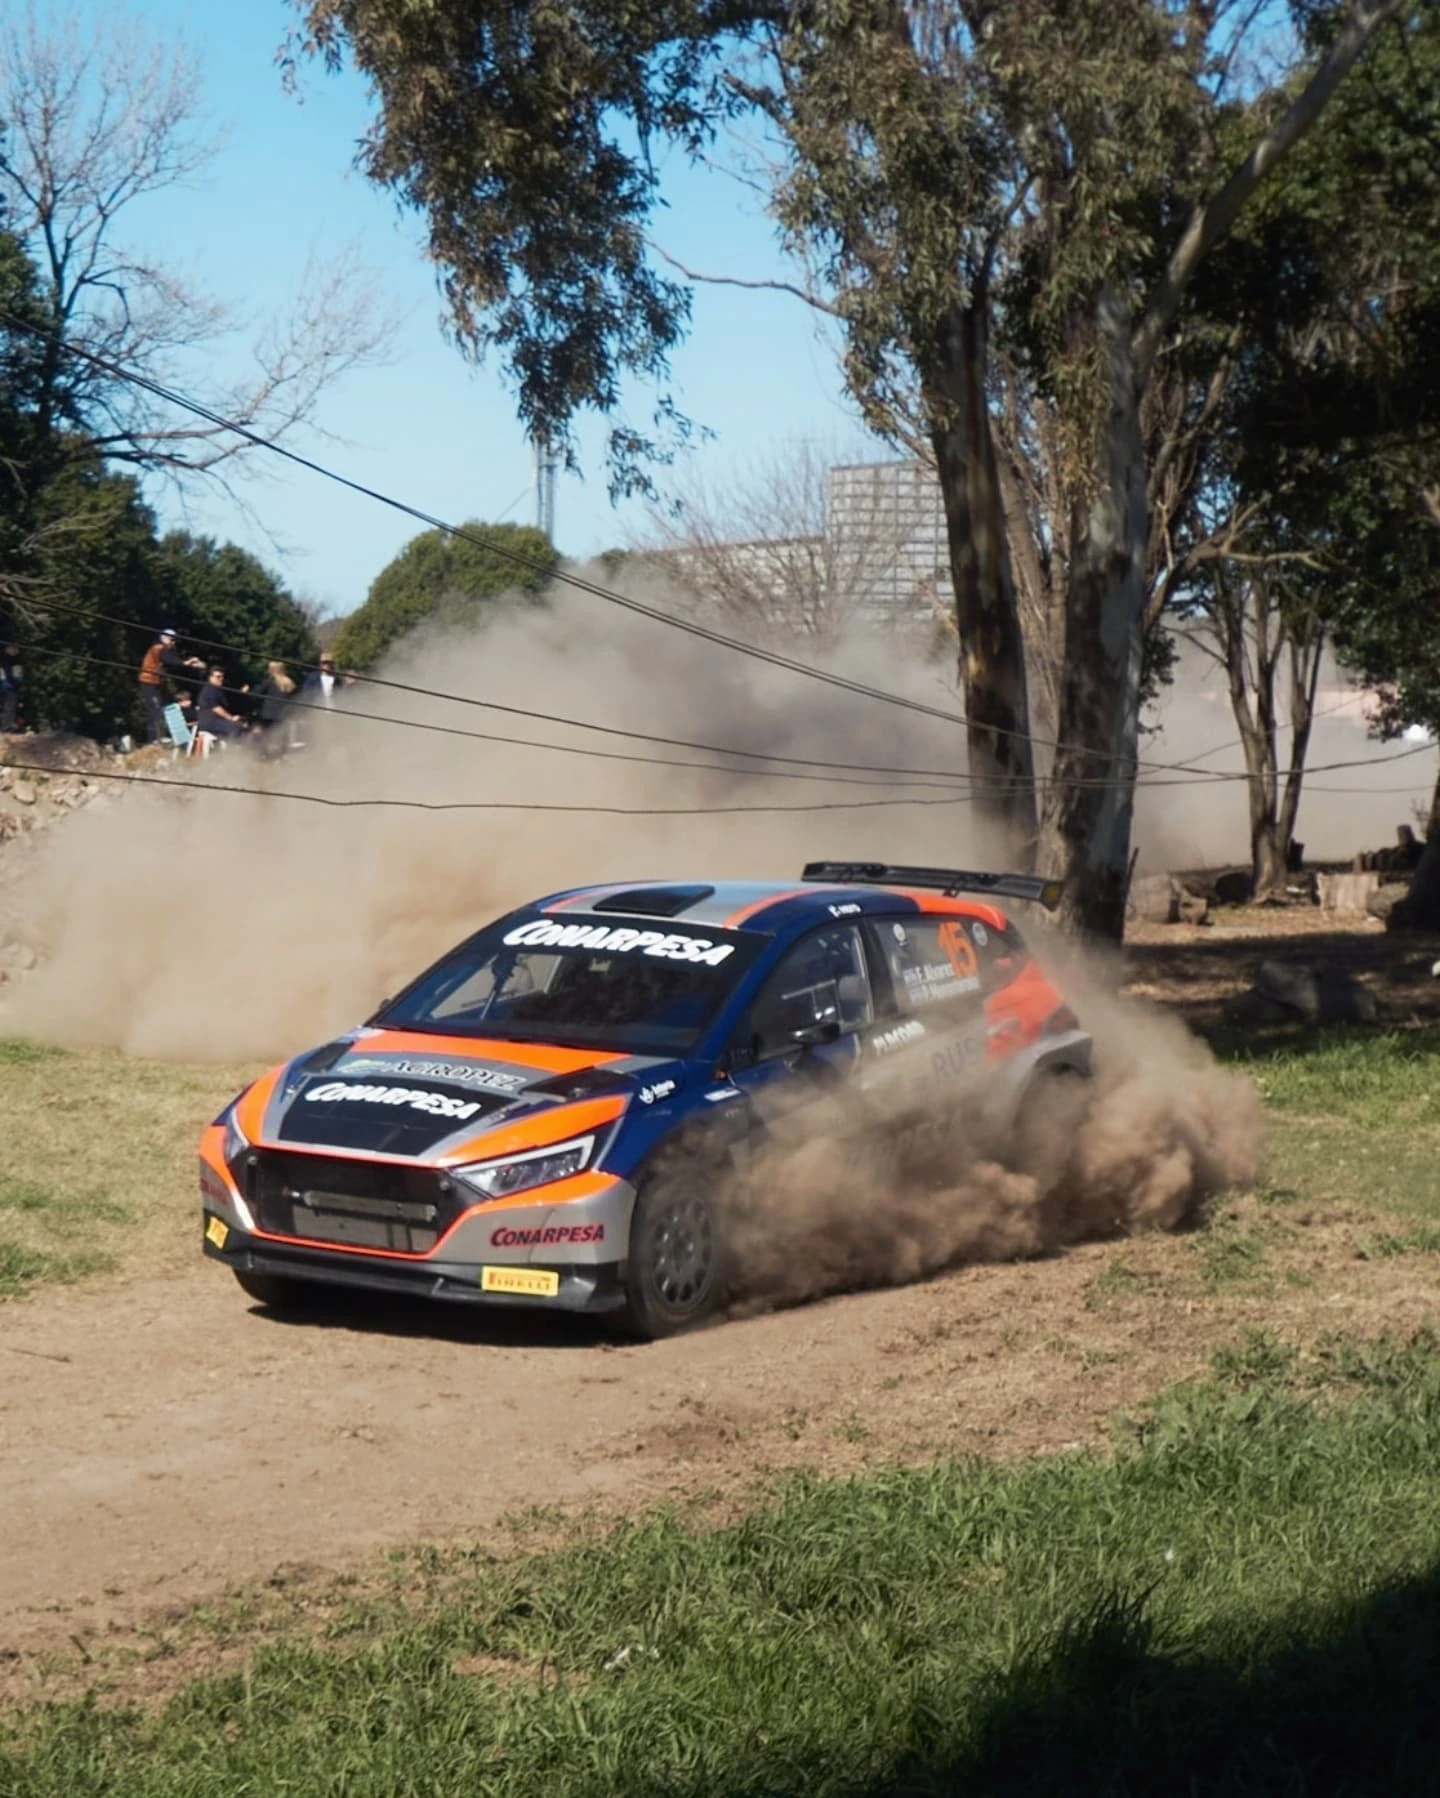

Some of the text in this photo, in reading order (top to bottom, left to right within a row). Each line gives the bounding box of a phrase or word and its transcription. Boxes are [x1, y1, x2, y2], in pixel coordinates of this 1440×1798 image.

[502, 919, 735, 967] CONARPESA
[937, 920, 977, 978] 15
[305, 1081, 482, 1120] CONARPESA
[489, 1223, 605, 1248] CONARPESA
[487, 1271, 552, 1292] PIRELLI
